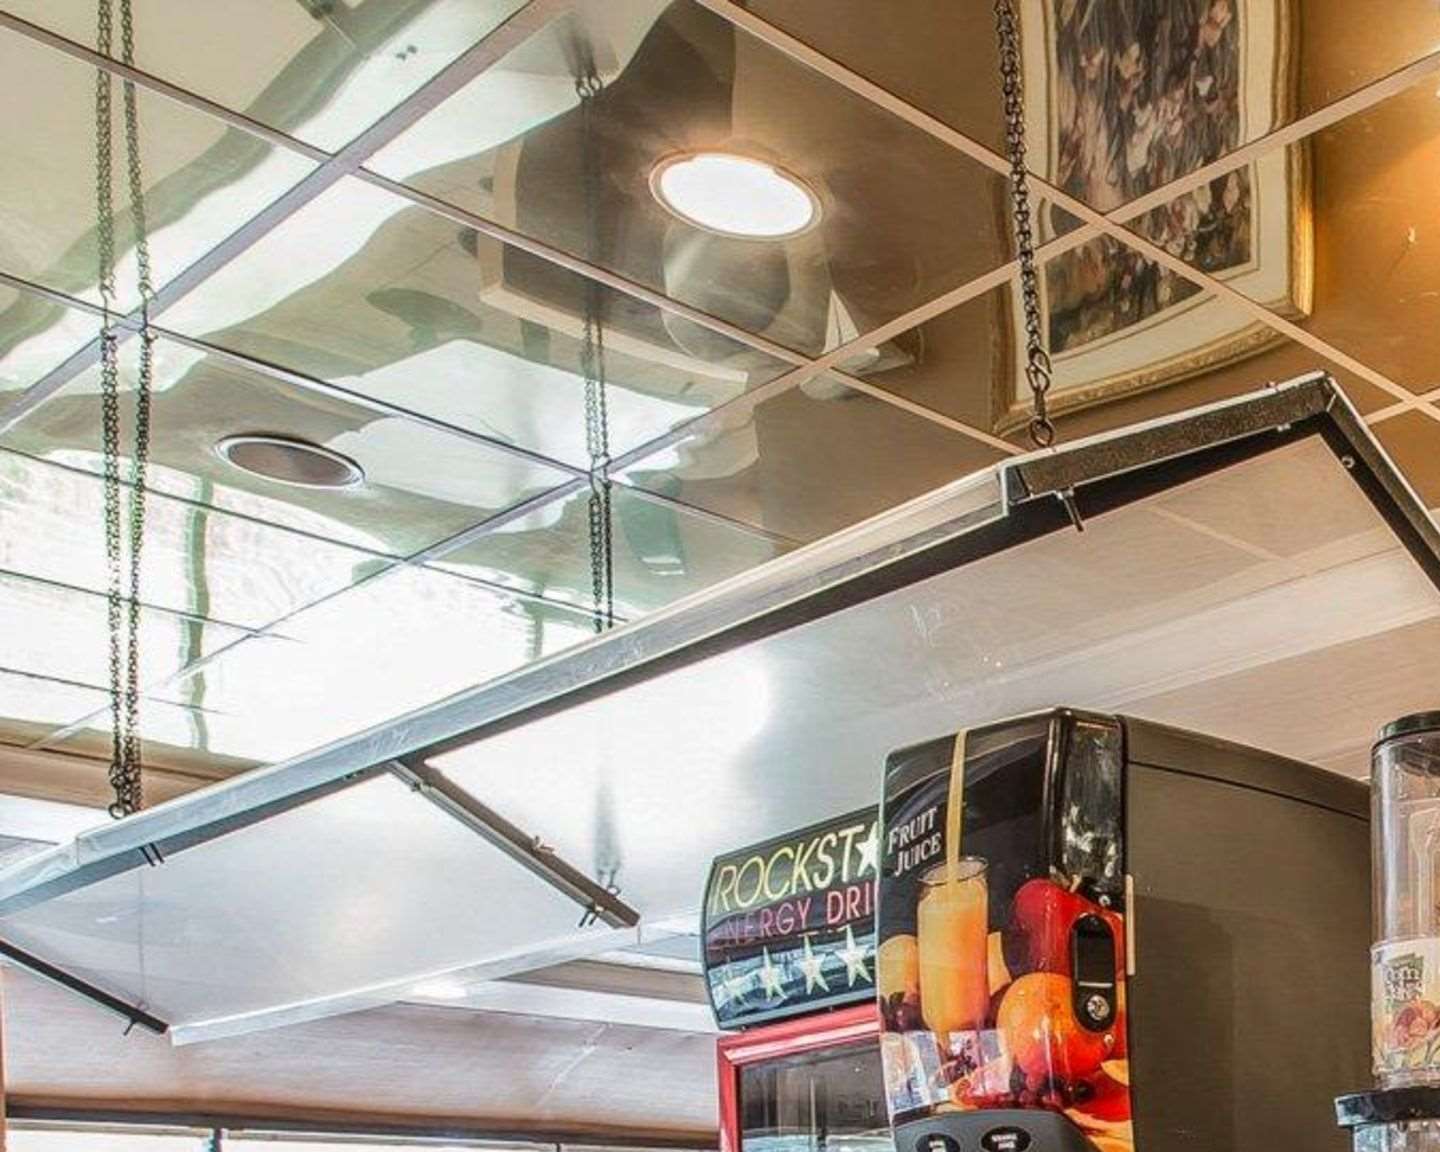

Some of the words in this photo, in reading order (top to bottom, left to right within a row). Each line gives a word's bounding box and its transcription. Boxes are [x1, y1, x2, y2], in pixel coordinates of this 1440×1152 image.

[887, 806, 938, 855] FRUIT
[894, 831, 943, 878] JUICE
[826, 881, 871, 924] DRI
